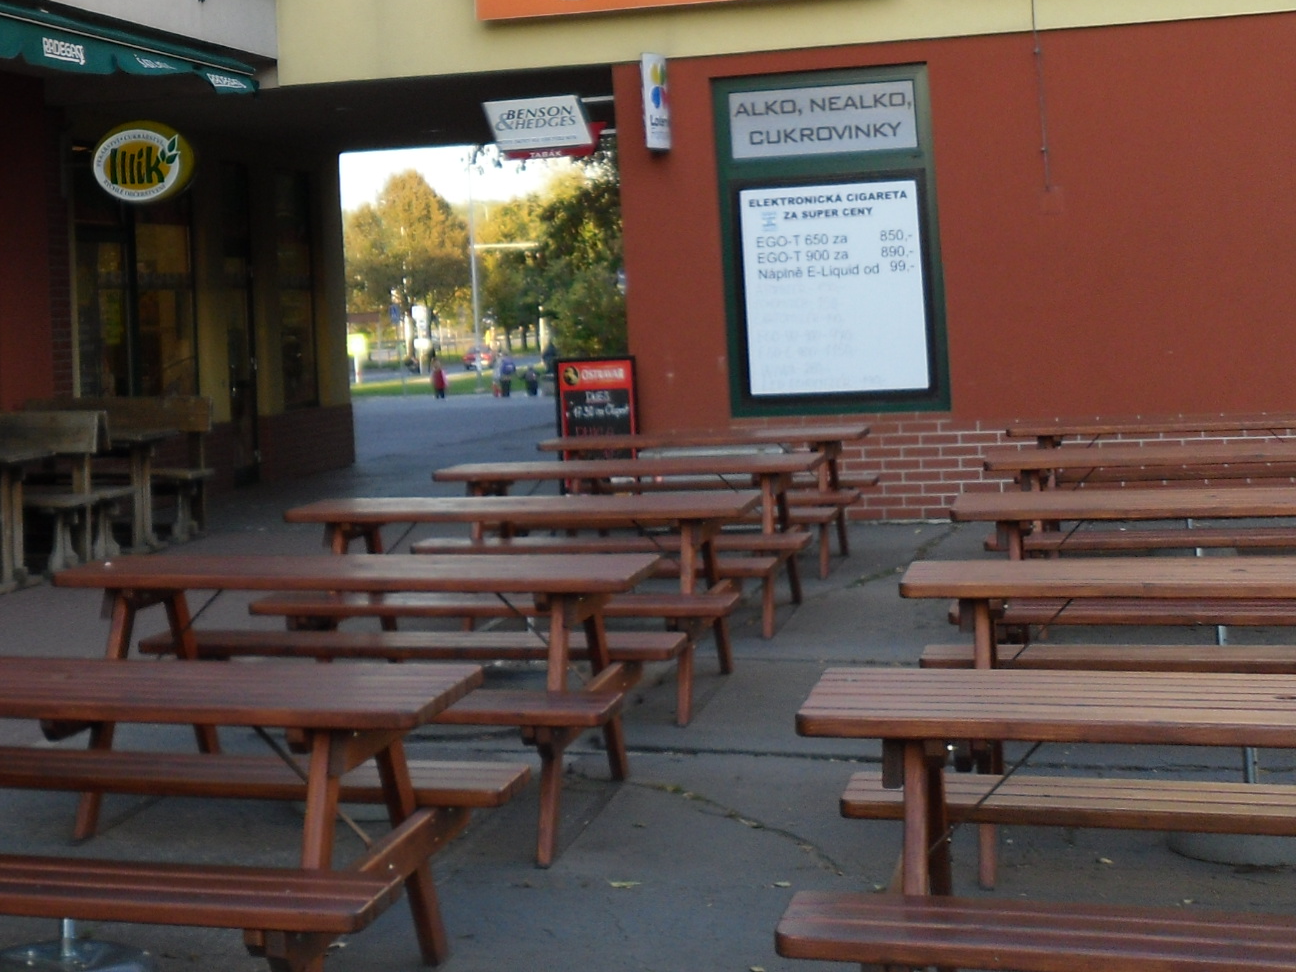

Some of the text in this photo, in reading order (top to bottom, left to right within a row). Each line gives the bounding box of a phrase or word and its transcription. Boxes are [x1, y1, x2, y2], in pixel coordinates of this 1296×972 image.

[506, 105, 574, 121] BENSON
[733, 92, 913, 119] ALKO, NEALKO,
[514, 114, 577, 131] HEDGES
[749, 121, 902, 146] CUKROVINKY
[846, 190, 908, 203] CIGARETA
[783, 206, 873, 220] ZA SUPER CENY
[756, 235, 800, 249] EGO-T
[805, 233, 829, 246] 650
[833, 235, 848, 245] za
[757, 251, 802, 265] EGO-T
[806, 249, 830, 262] 900
[833, 251, 849, 260] za
[807, 264, 859, 279] E-Liquid
[864, 263, 880, 275] od
